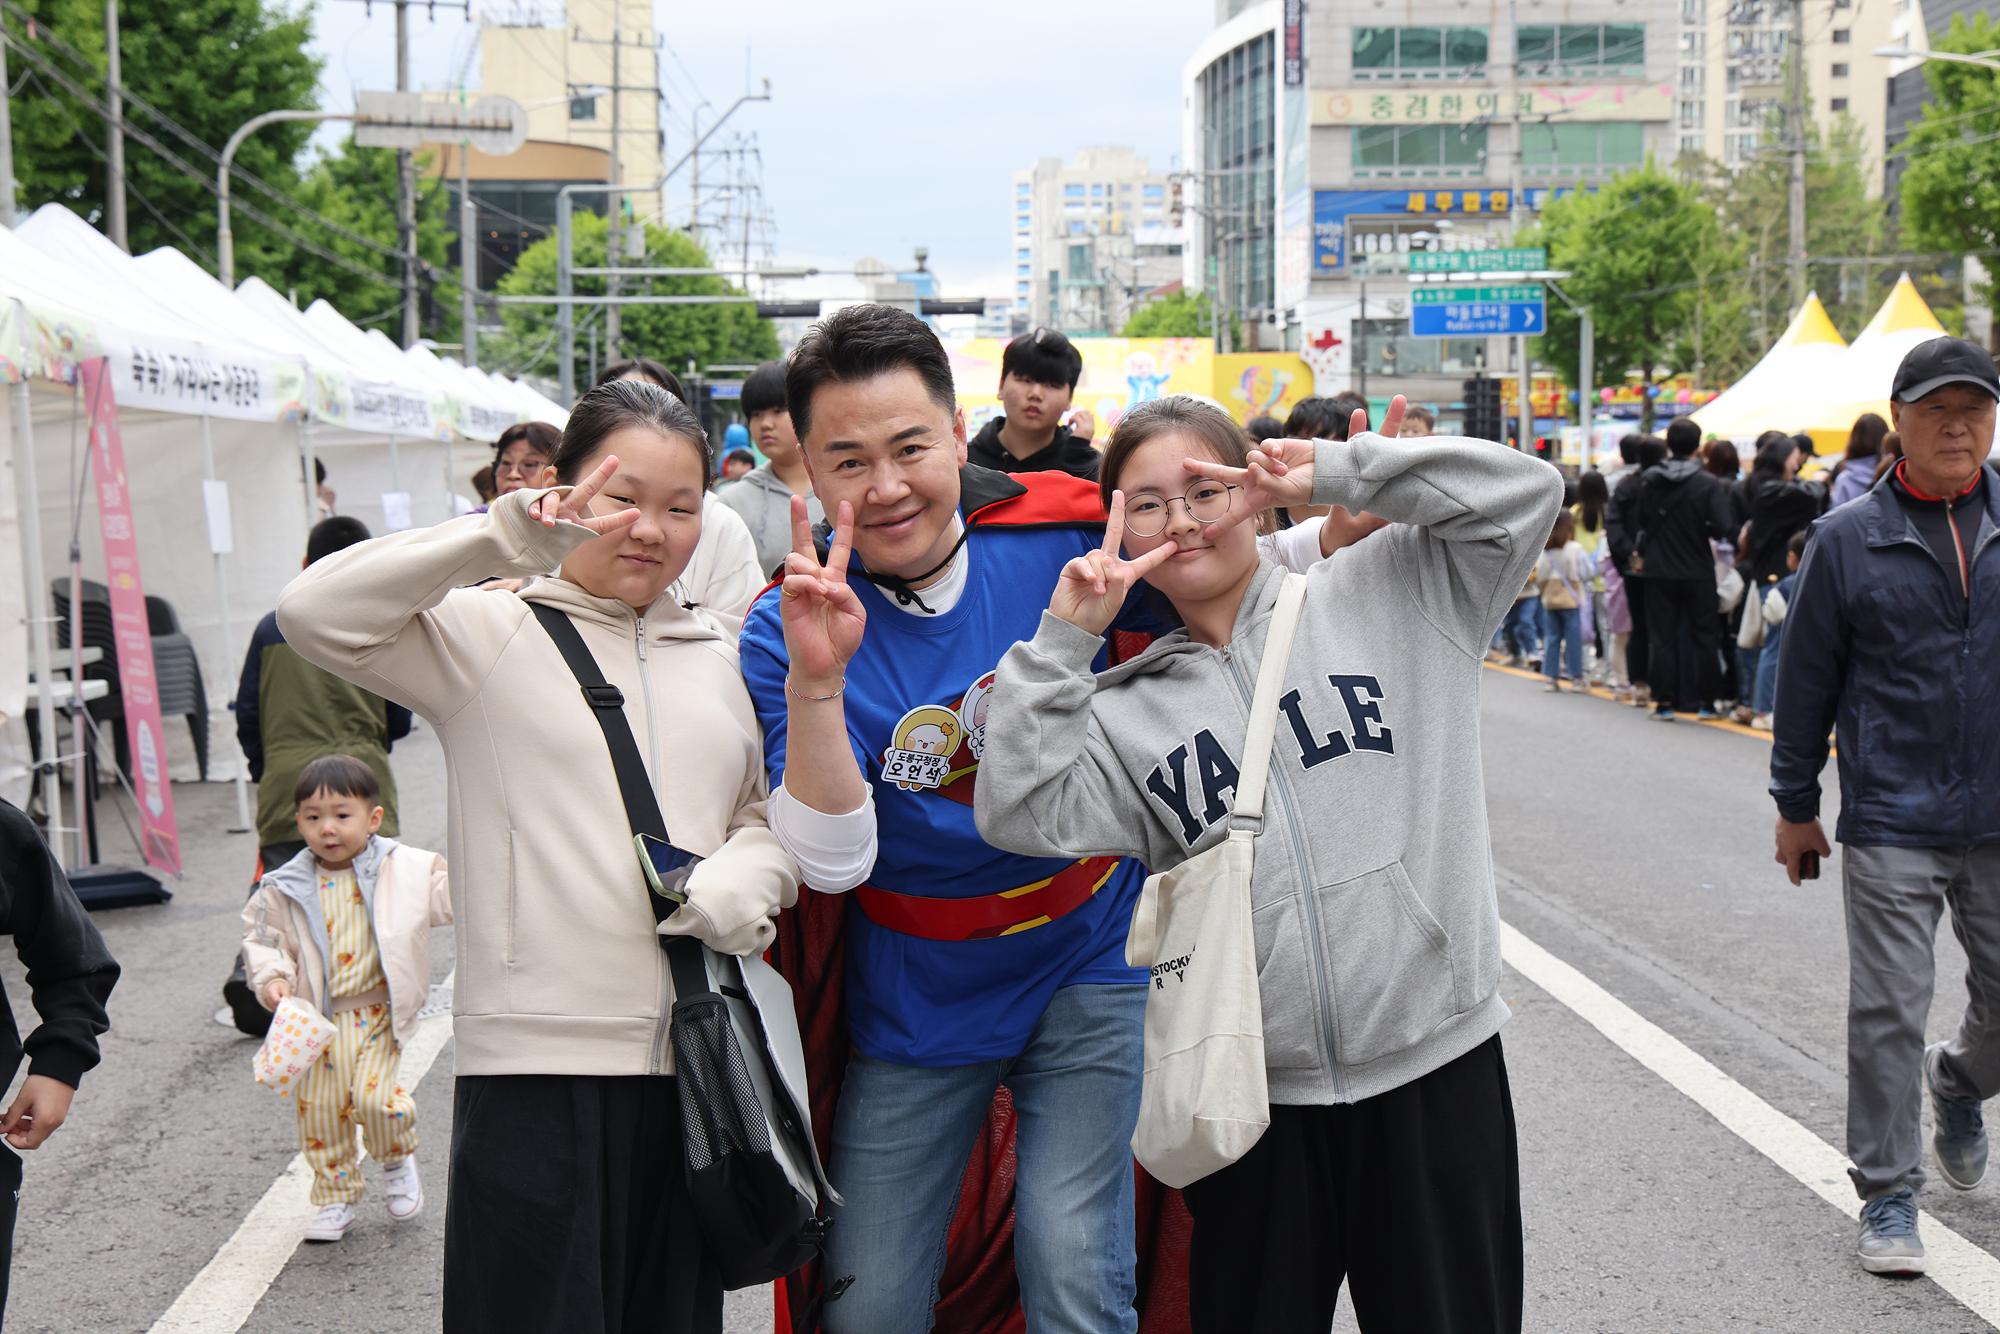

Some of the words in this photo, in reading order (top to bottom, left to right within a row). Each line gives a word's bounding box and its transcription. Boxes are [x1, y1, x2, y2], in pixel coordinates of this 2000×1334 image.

[896, 752, 941, 768] 도봉구청장
[1145, 673, 1395, 848] YALE
[888, 762, 940, 783] 오언석
